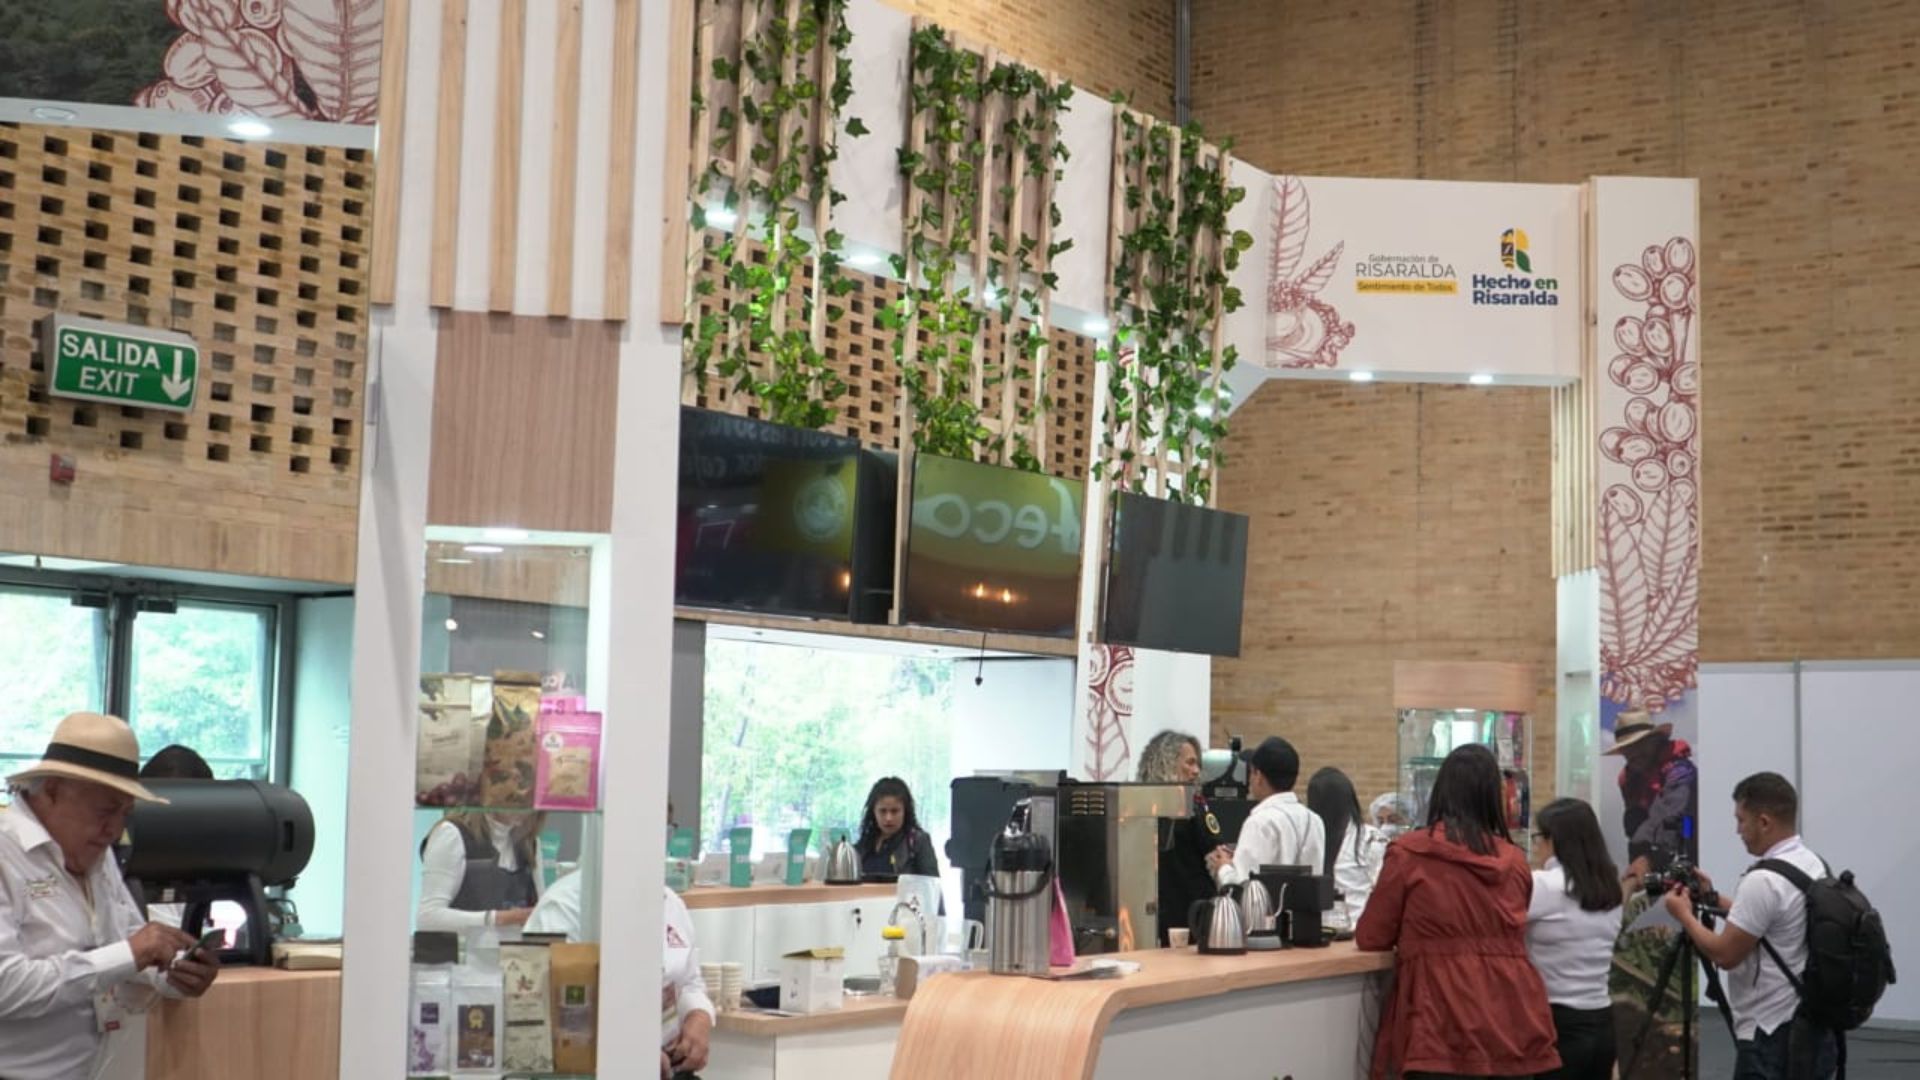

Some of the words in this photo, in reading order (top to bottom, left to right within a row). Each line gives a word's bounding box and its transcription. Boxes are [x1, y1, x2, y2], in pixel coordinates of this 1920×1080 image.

[1368, 253, 1426, 263] Gobernación
[1428, 253, 1439, 263] de
[1355, 262, 1457, 278] RISARALDA
[1472, 274, 1531, 289] Hecho
[1534, 278, 1558, 290] en
[1472, 289, 1558, 305] Risaralda
[62, 334, 161, 371] SALIDA
[79, 367, 139, 396] EXIT
